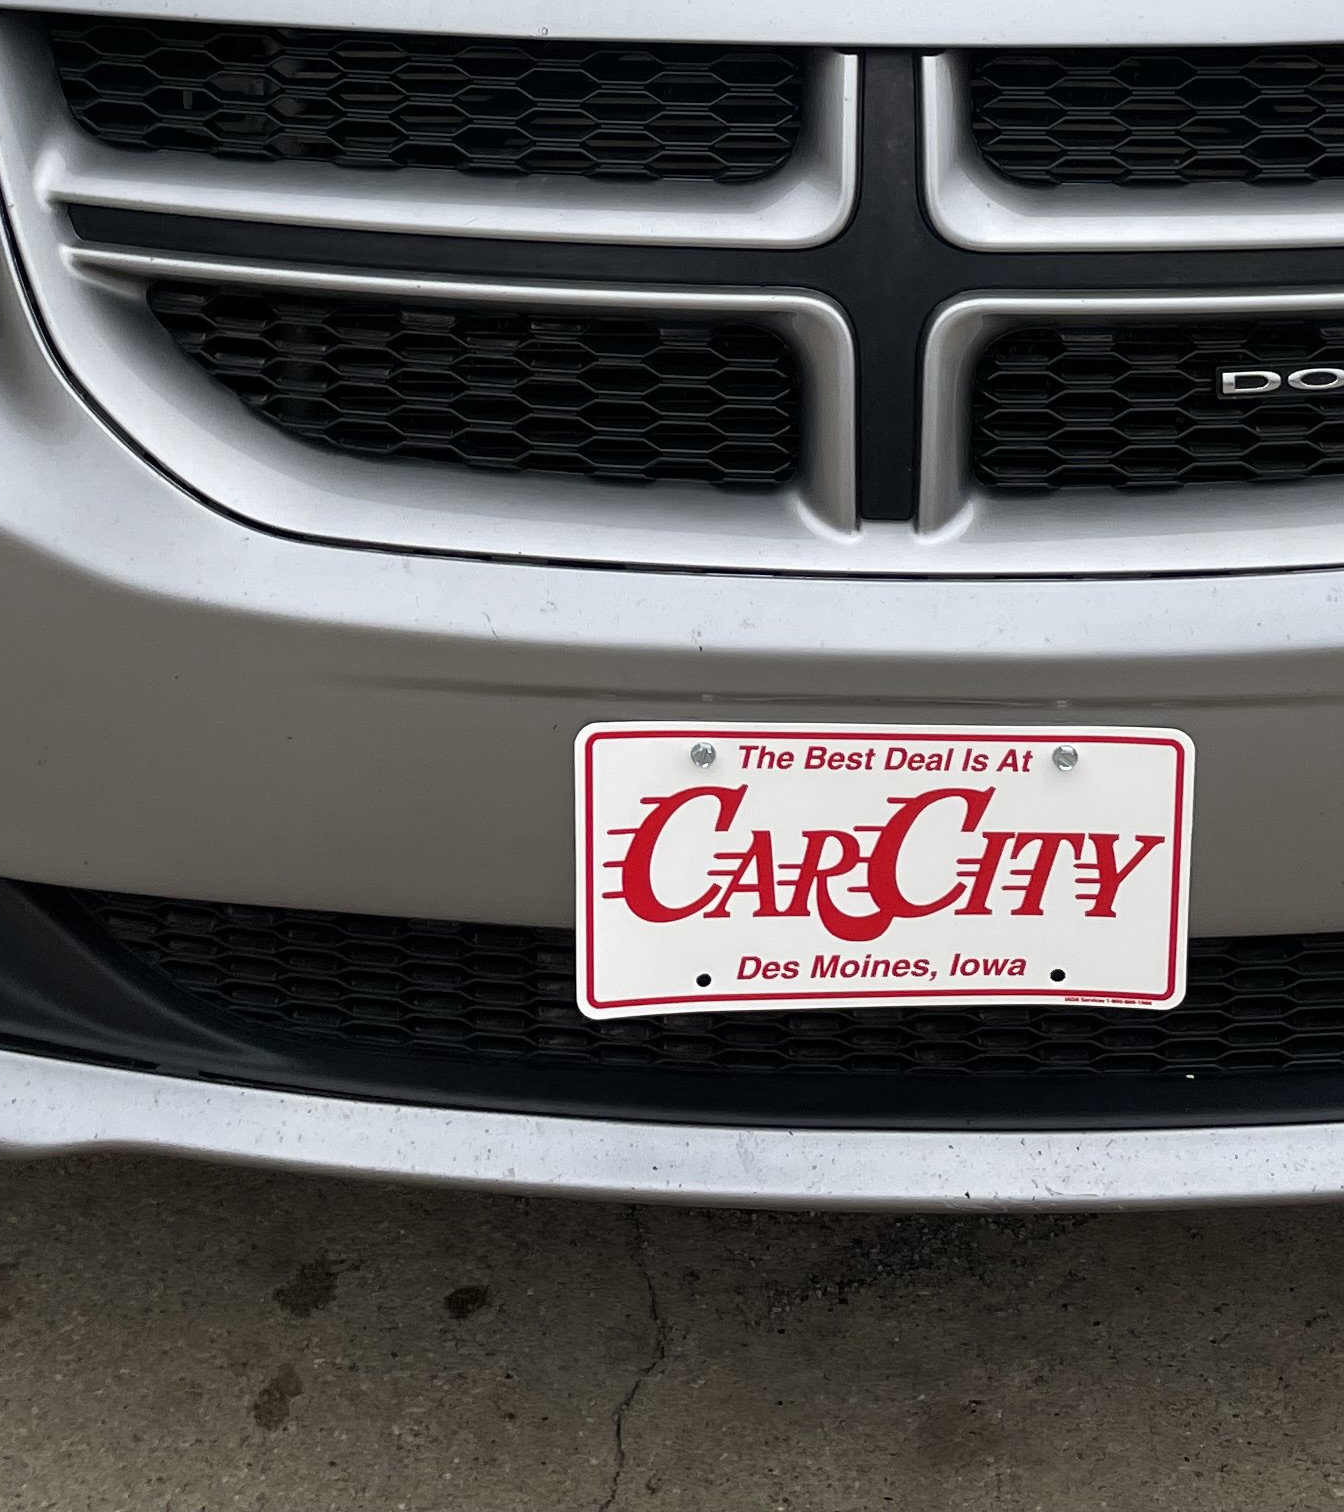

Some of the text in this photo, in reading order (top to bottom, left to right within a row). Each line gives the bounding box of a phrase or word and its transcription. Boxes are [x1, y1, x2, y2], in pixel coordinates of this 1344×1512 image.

[738, 745, 1034, 773] The Best Deal Is At
[736, 953, 1028, 982] Des Moines, Iowa
